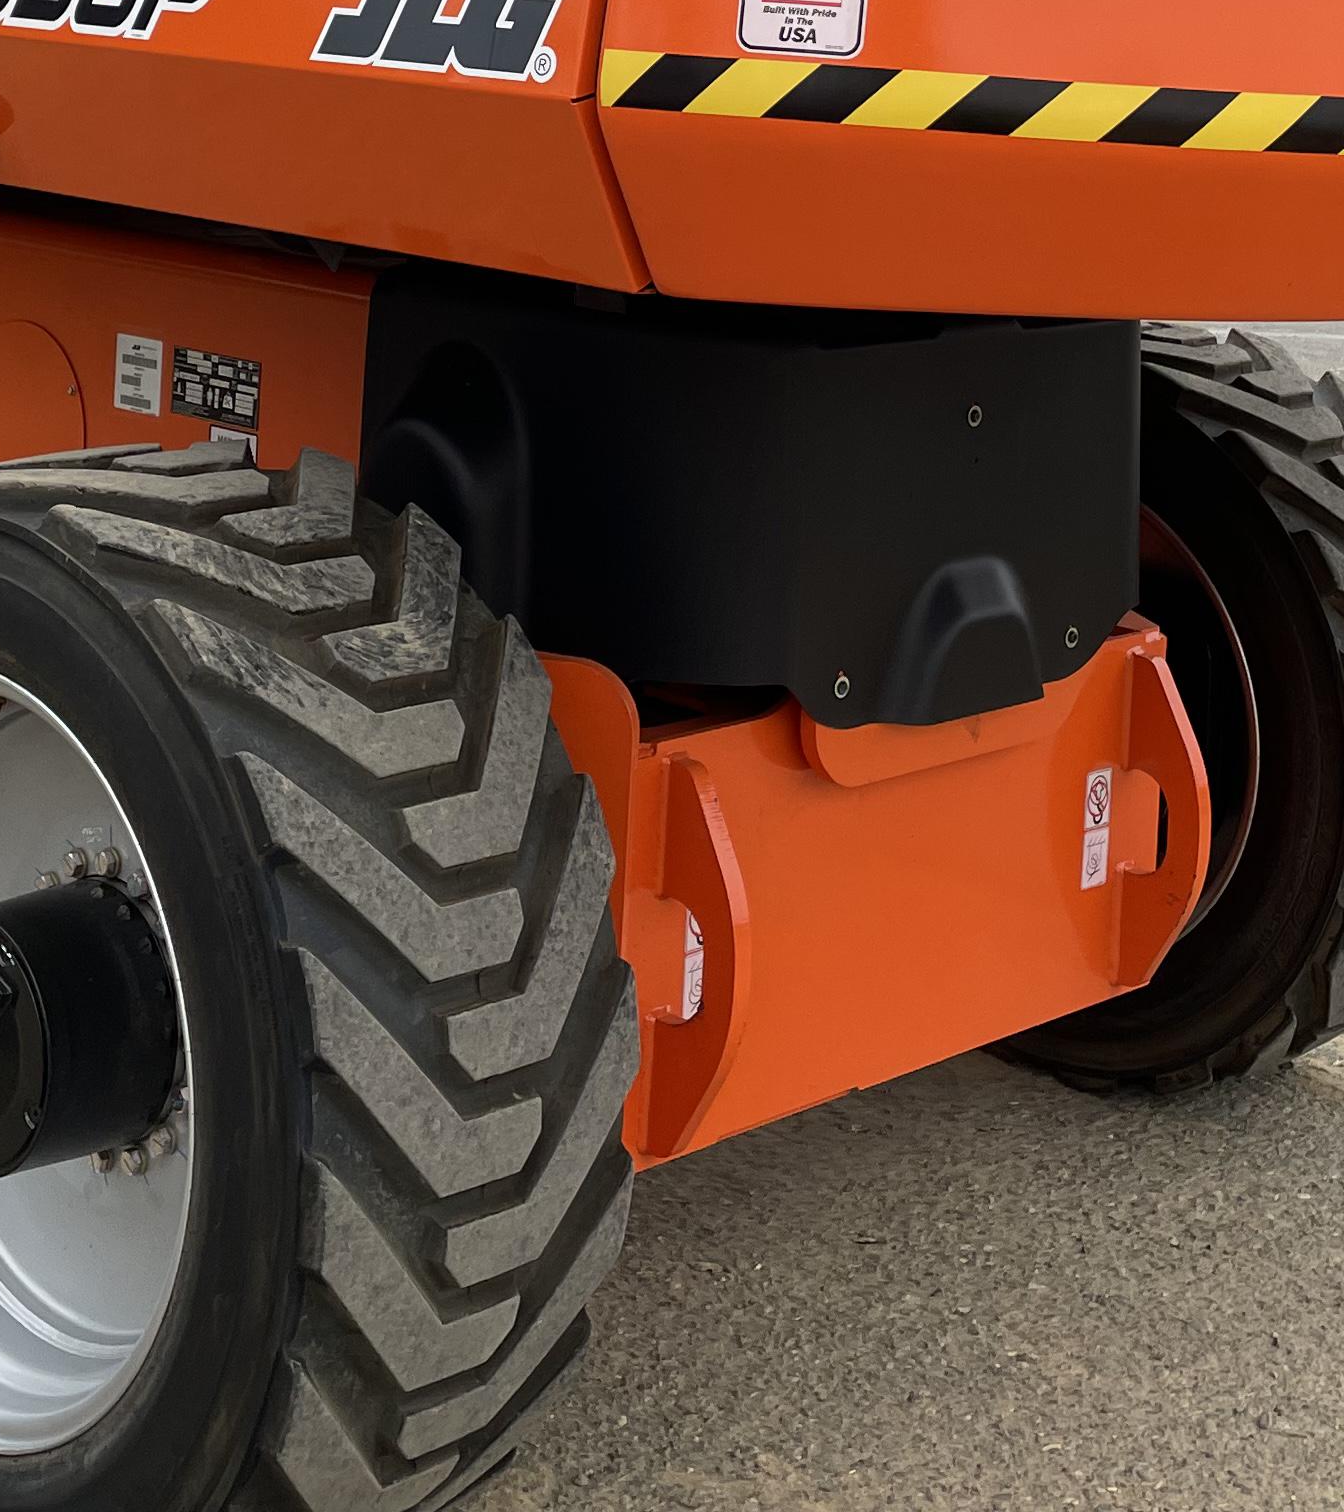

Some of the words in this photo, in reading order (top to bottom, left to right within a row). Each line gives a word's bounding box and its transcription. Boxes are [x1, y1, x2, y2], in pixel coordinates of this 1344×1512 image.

[763, 5, 785, 14] Built
[788, 7, 809, 16] With
[812, 9, 837, 18] Pride
[797, 18, 813, 26] The
[779, 26, 817, 43] USA
